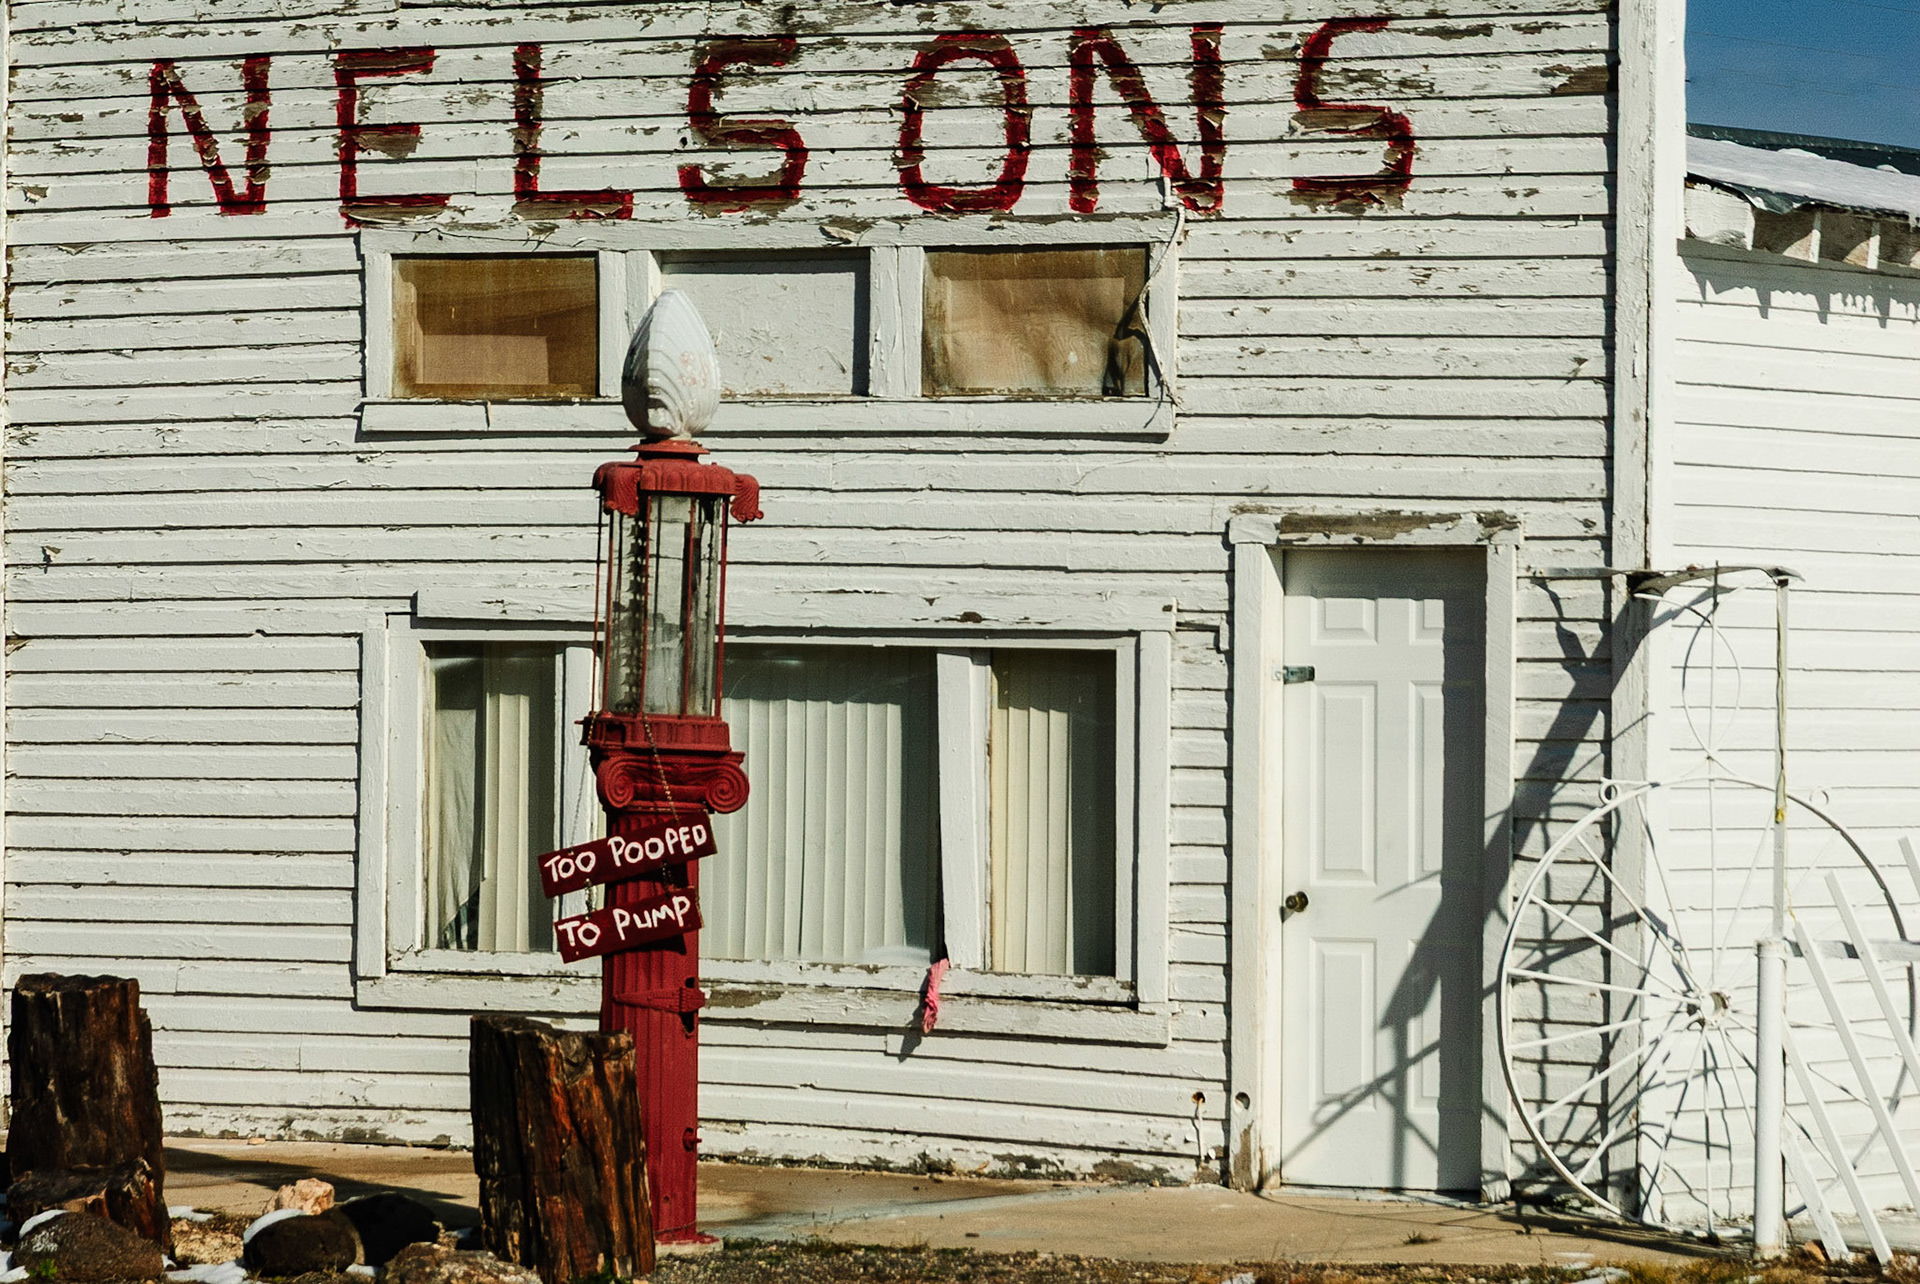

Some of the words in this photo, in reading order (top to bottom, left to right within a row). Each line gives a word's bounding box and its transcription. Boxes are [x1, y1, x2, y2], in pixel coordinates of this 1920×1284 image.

[149, 16, 1413, 226] NELSONS
[544, 851, 596, 882] TOO
[607, 824, 707, 867] POOPED
[557, 920, 601, 947] TO
[612, 896, 691, 940] PUMP
